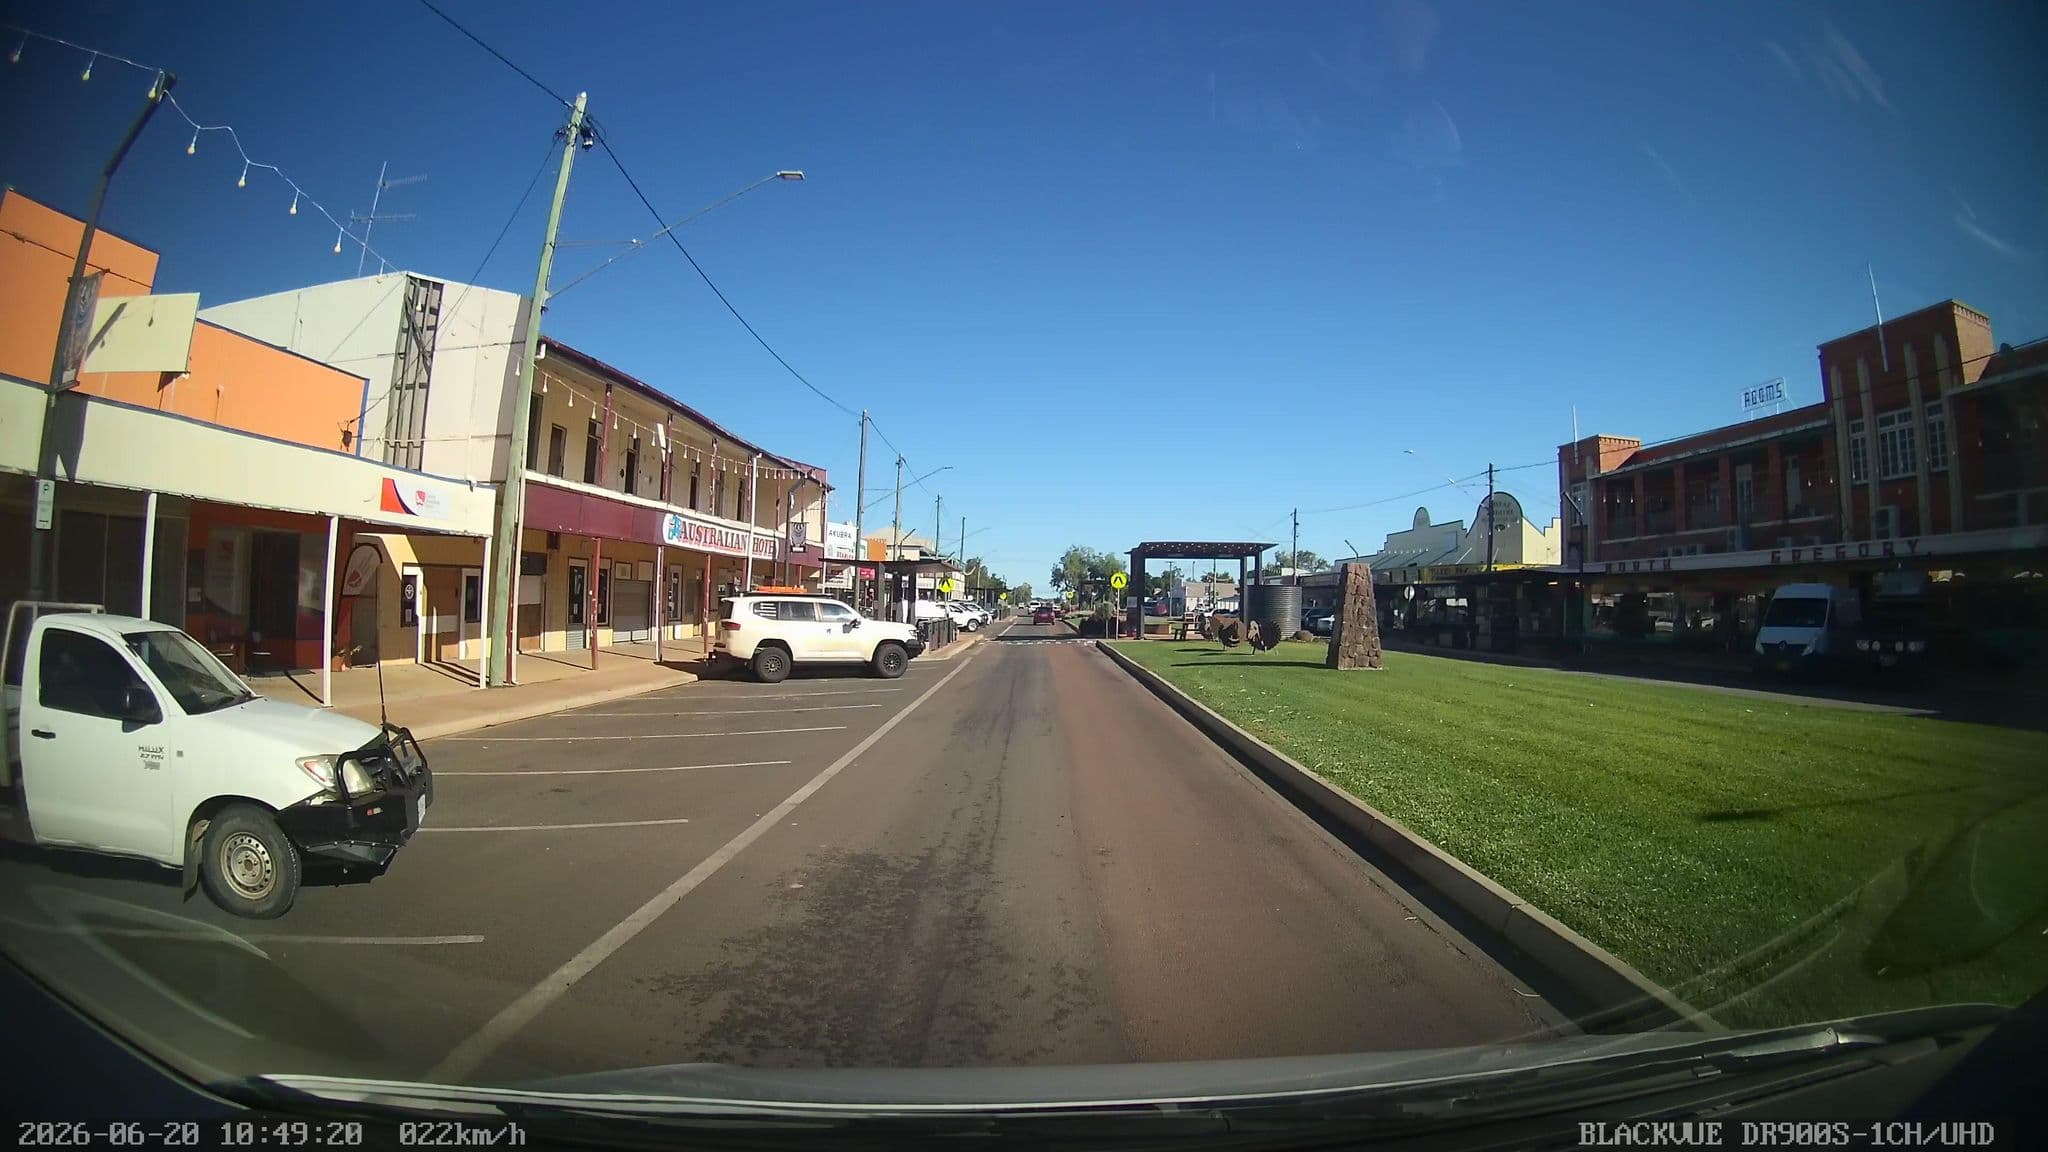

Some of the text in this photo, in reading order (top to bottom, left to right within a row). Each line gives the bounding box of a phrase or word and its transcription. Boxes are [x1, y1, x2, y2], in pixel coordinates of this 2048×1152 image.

[1744, 382, 1783, 408] ROOMS
[679, 520, 776, 555] AUSTRALIAN HOTE
[828, 529, 852, 540] AKUBRA
[1770, 538, 1920, 564] GREGORY
